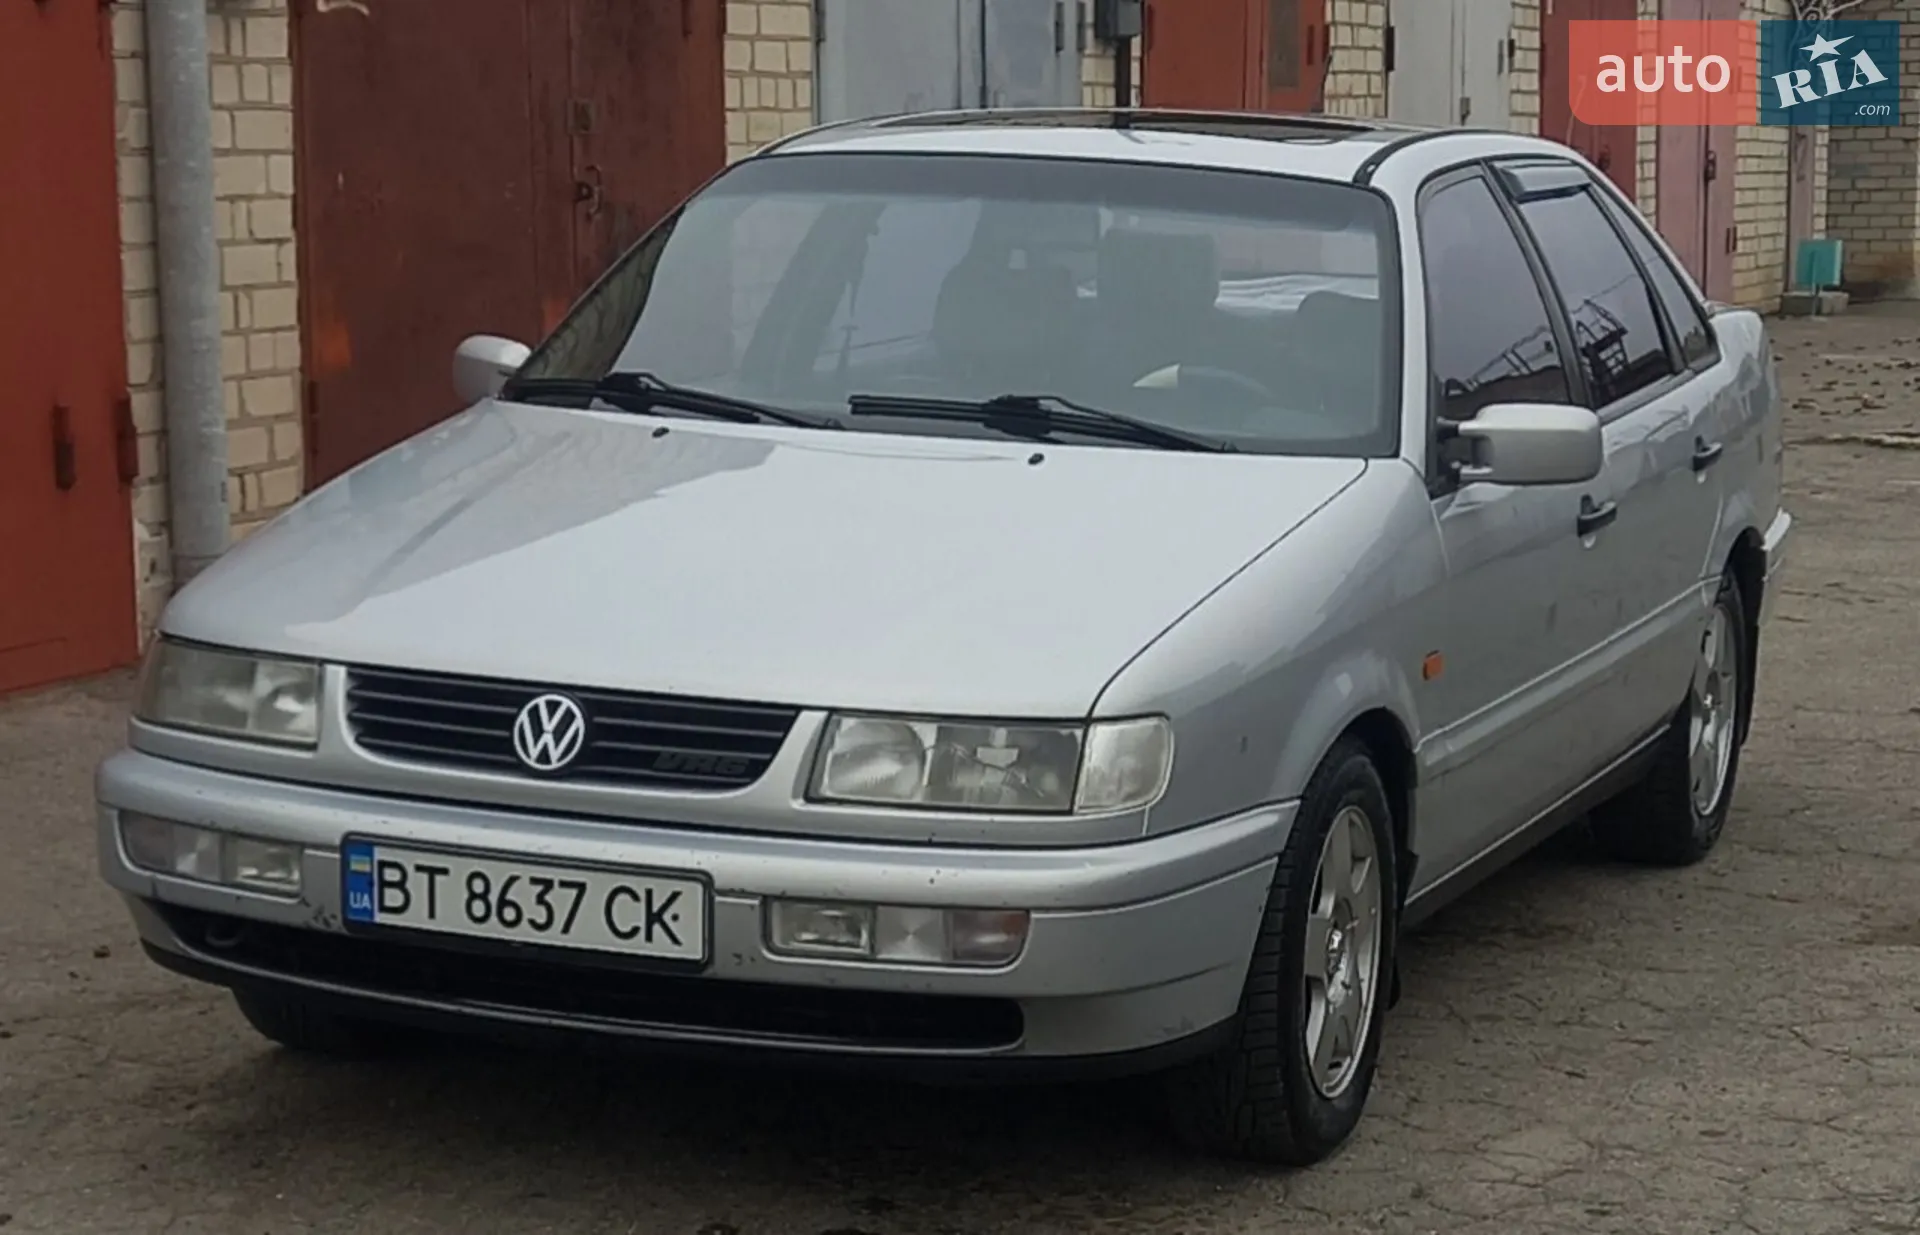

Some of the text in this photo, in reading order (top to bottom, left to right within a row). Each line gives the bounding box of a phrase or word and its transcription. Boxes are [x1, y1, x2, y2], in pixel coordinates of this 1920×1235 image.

[350, 891, 372, 910] UA
[377, 860, 450, 920] BT
[465, 870, 588, 936] 8637
